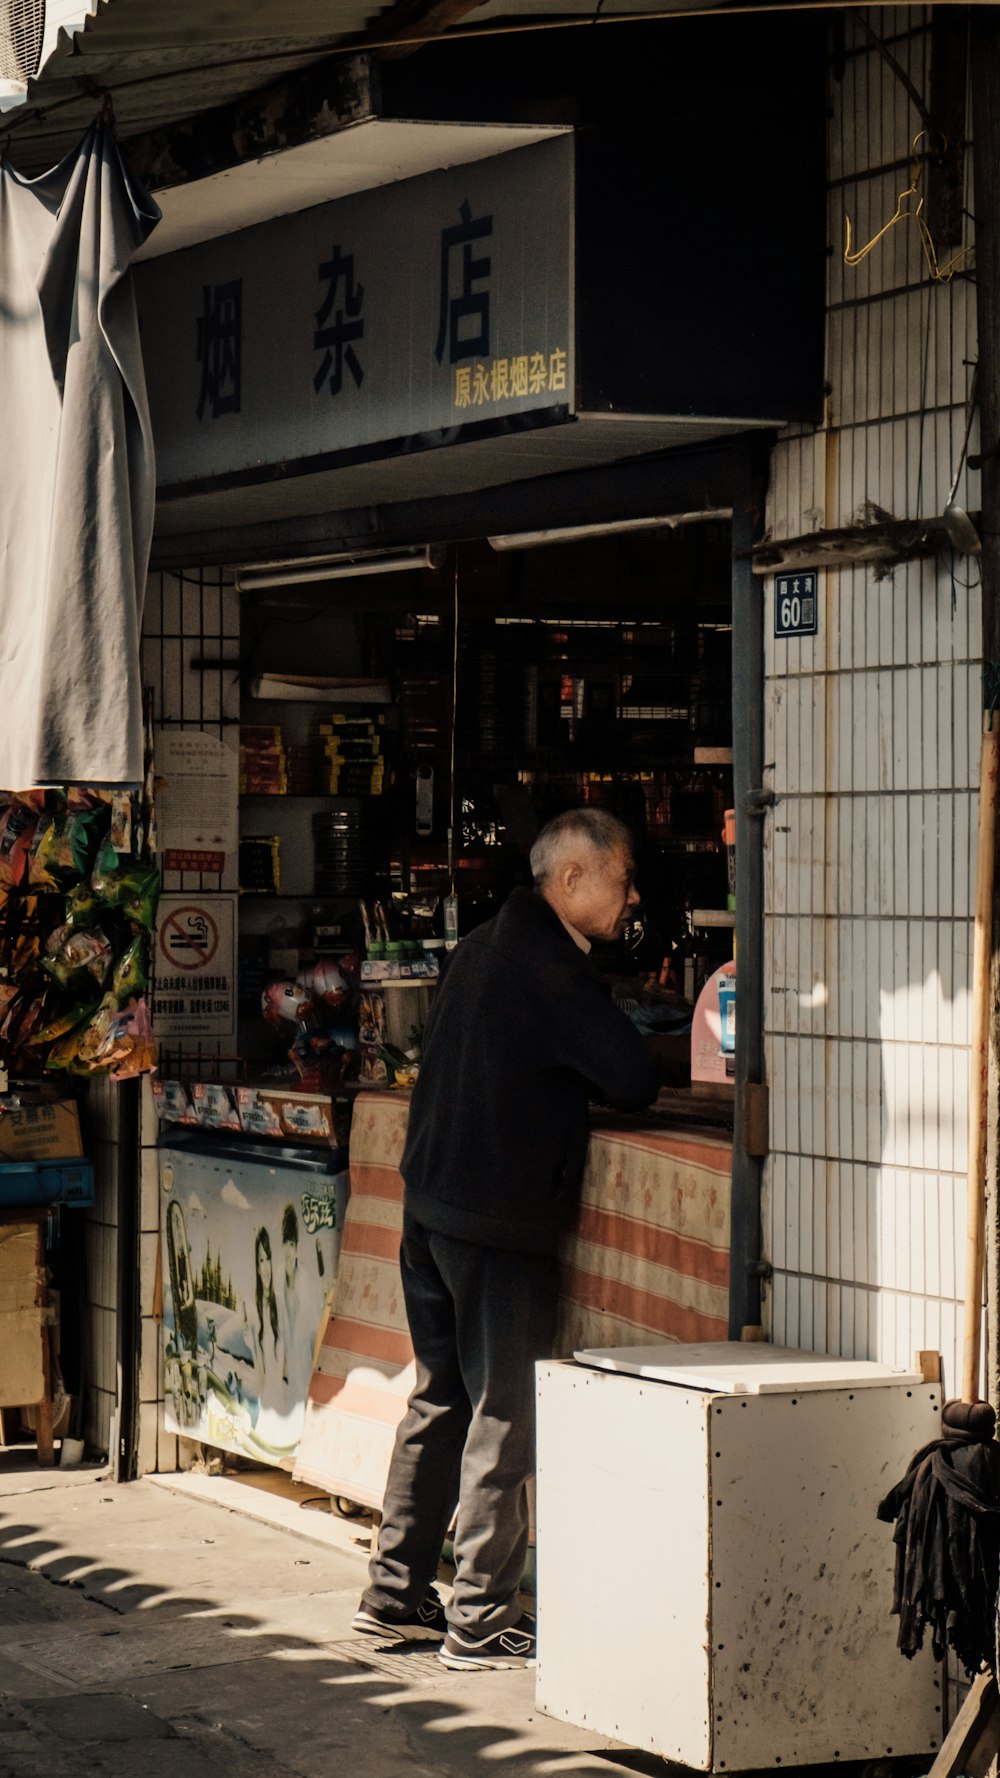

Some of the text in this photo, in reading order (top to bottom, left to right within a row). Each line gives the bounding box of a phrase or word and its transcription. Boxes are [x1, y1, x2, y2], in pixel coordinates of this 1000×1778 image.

[196, 198, 493, 424] 烟杂店
[454, 346, 567, 408] 原永根烟杂店
[781, 597, 801, 628] 60
